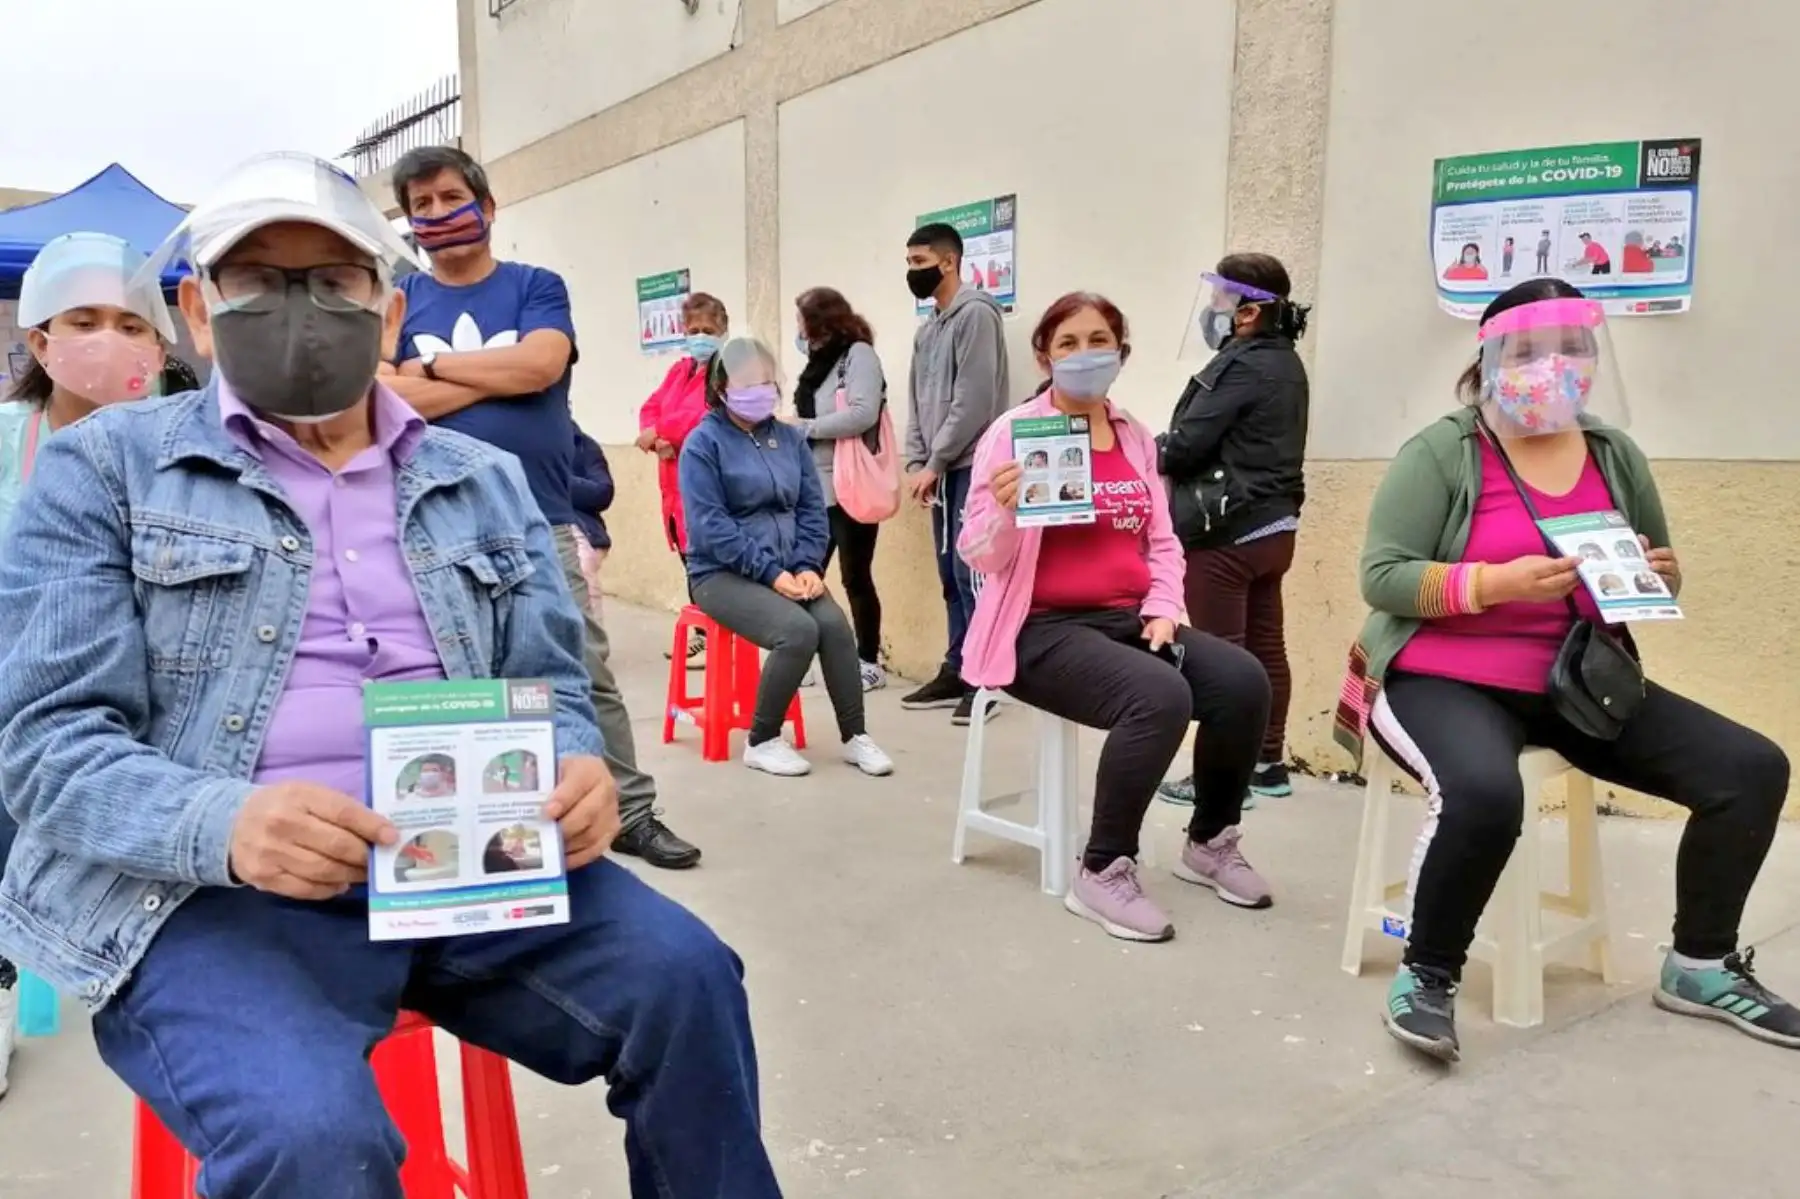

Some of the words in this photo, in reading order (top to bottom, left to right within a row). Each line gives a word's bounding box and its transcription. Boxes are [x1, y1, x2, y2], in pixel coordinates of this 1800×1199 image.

[1447, 166, 1477, 176] Cuida
[1478, 164, 1490, 173] tu
[1492, 161, 1520, 172] salud
[1521, 161, 1529, 172] y
[1558, 156, 1570, 165] tu
[1647, 156, 1670, 176] NO
[1446, 177, 1507, 192] Protégete
[1508, 175, 1525, 185] de
[1526, 174, 1539, 184] la
[1541, 164, 1624, 182] COVID-19
[1092, 480, 1147, 496] ream
